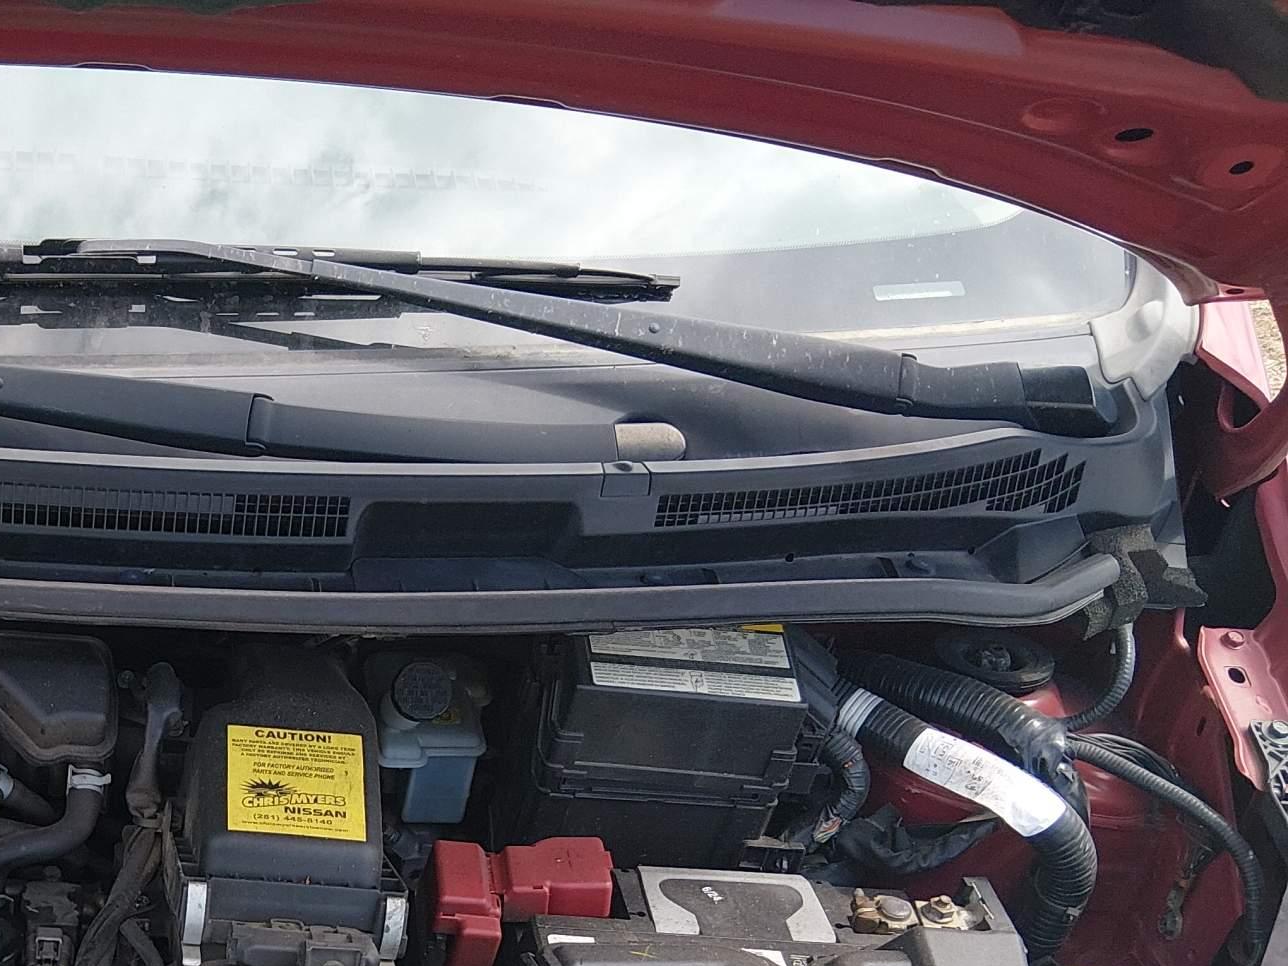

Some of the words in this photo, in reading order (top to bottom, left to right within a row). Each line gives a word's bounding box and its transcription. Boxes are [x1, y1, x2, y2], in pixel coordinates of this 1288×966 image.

[255, 729, 332, 744] CAUTION!
[296, 765, 334, 773] AUTHORIZED
[242, 794, 291, 808] CHRIS
[290, 793, 346, 806] MYERS
[284, 806, 346, 819] NISSAN
